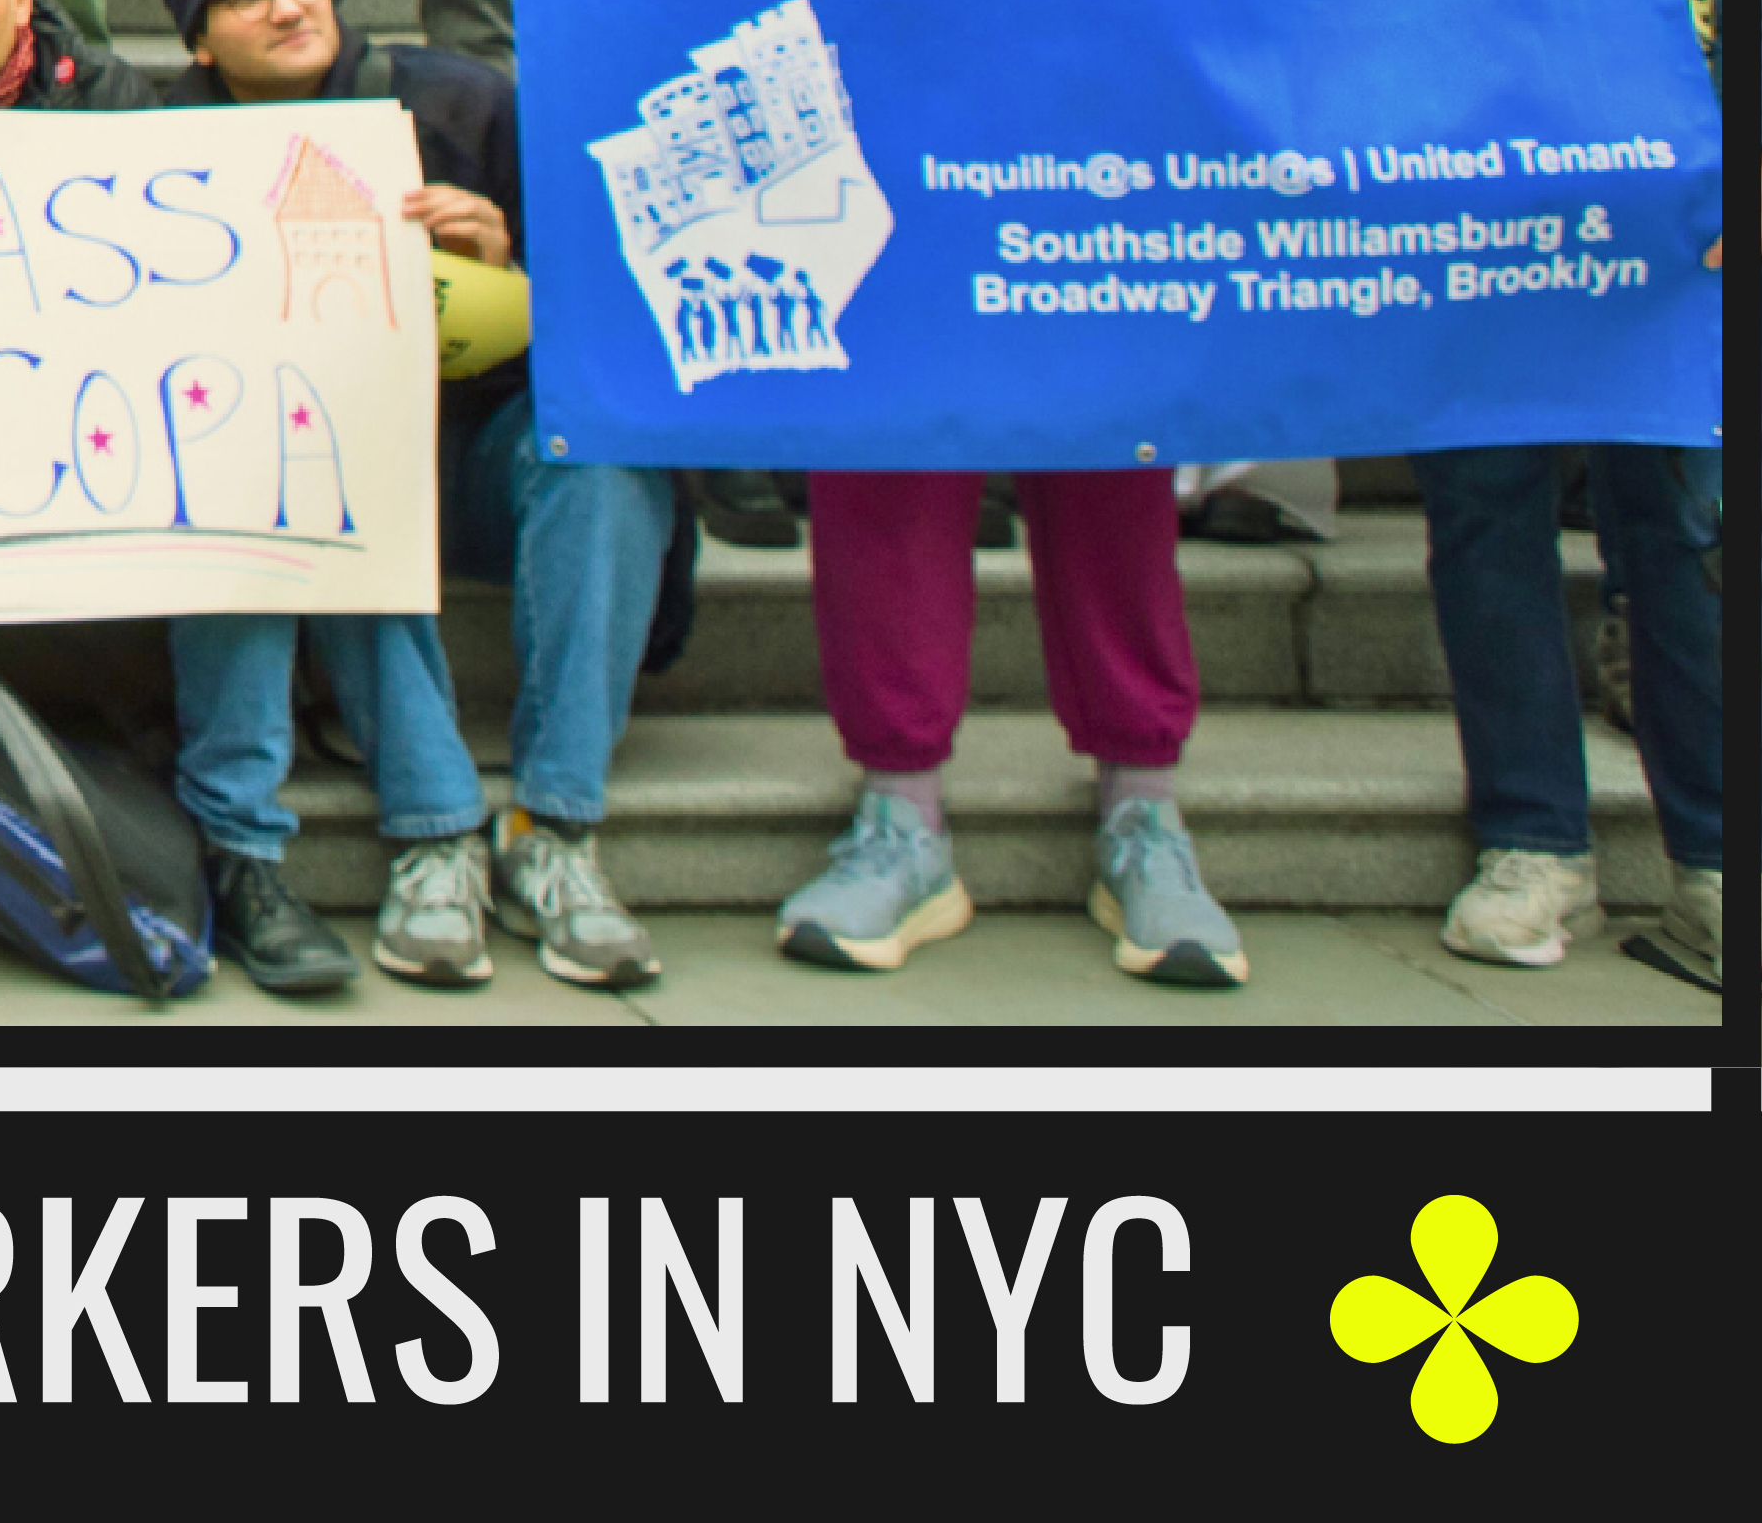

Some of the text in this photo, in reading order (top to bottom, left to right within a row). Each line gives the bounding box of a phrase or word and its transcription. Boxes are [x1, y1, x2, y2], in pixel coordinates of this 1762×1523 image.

[922, 133, 1677, 199] Inquilin@s Unid@s United Tenants
[997, 203, 1613, 265] Southside Williamsburg &
[973, 254, 1648, 322] Broadway Triangle, Brooklyn
